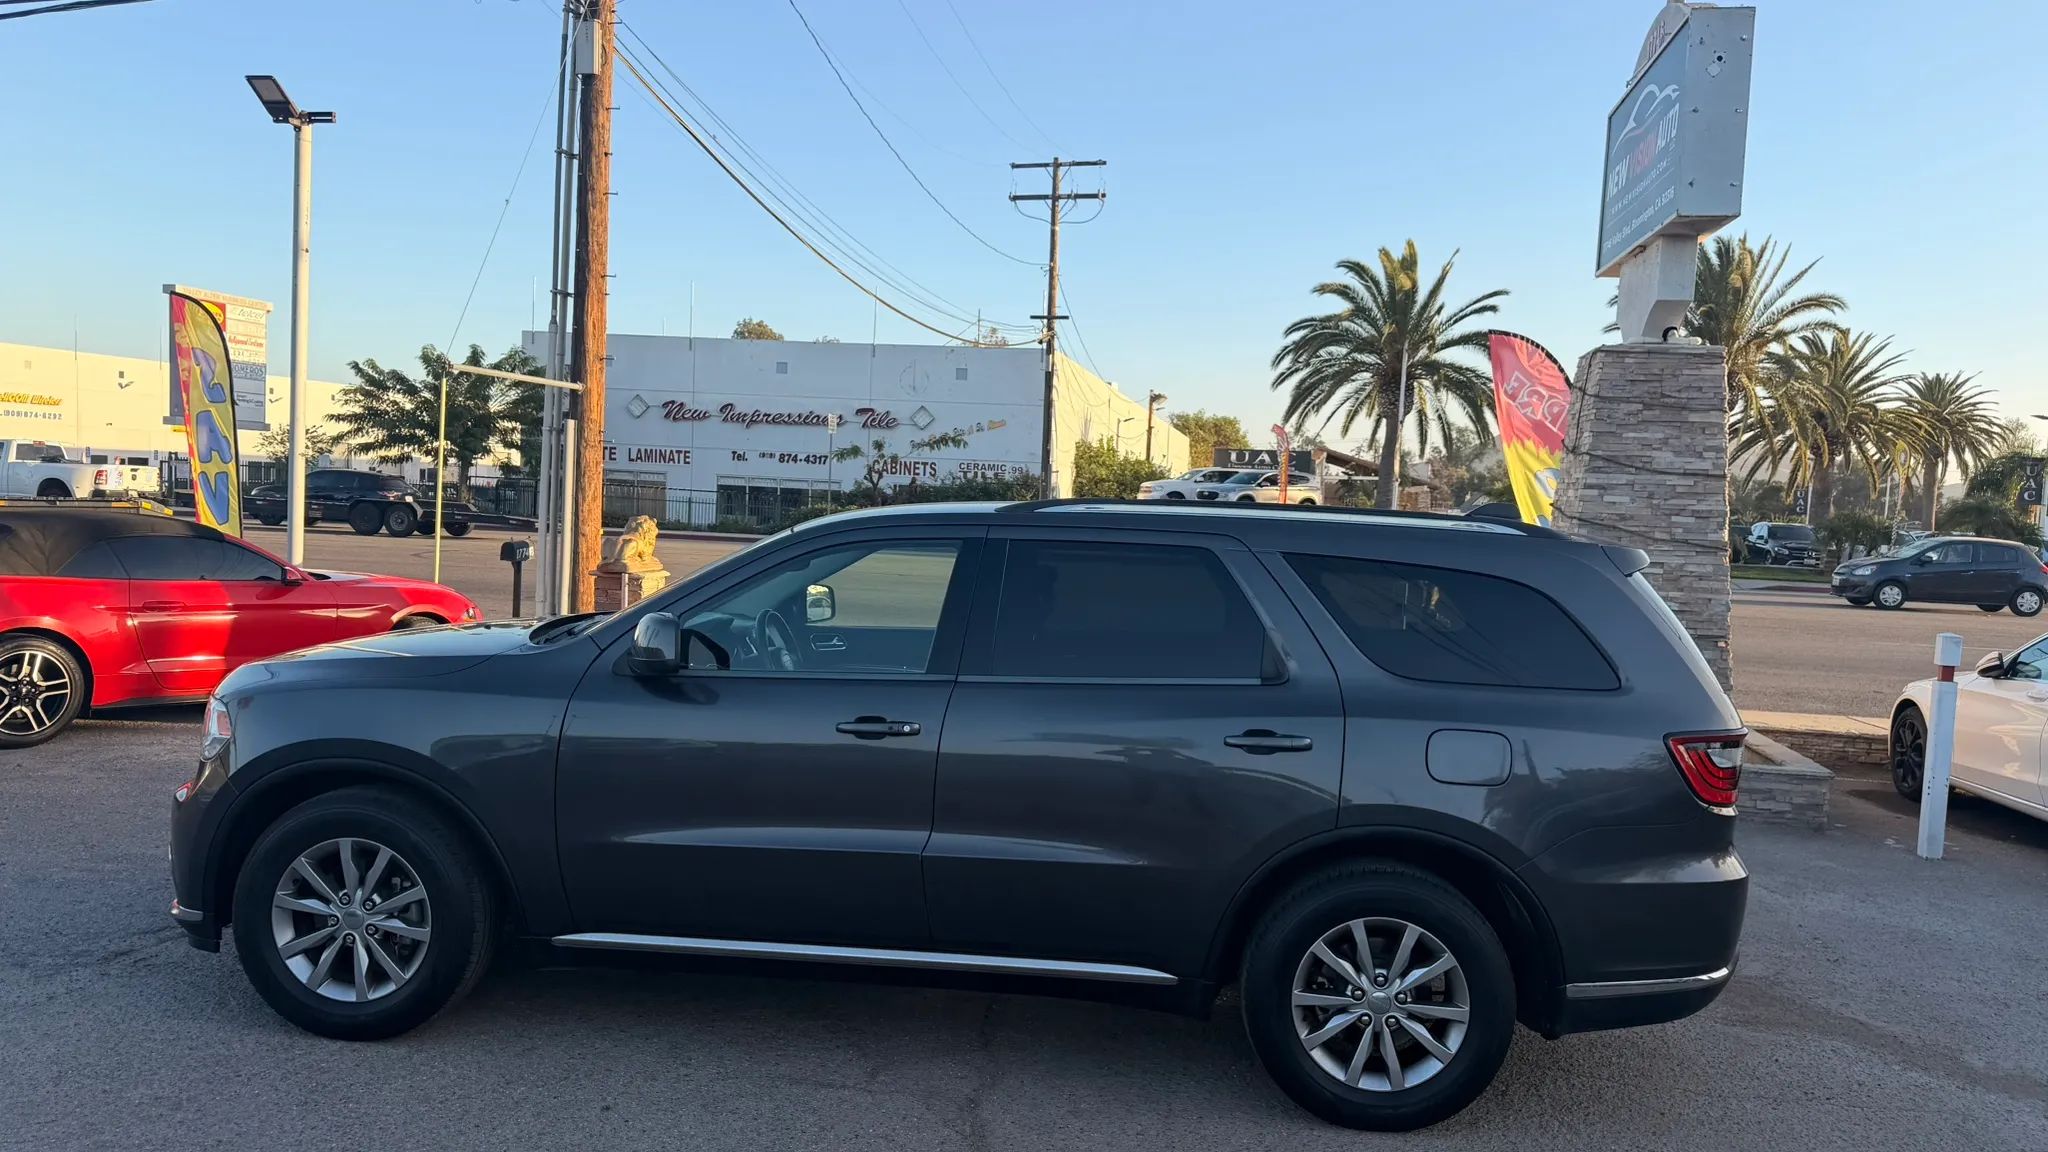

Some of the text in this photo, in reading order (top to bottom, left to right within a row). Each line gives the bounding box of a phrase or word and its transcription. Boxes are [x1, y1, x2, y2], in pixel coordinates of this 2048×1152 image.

[1606, 154, 1630, 201] NEW
[1656, 102, 1680, 154] AUTO
[661, 400, 711, 423] New
[855, 407, 900, 430] Tile
[628, 447, 691, 465] LAMINATE
[731, 450, 748, 462] Tel.
[778, 452, 829, 466] 874-4317
[872, 459, 938, 478] CABINETS
[958, 462, 1007, 473] CERAMIC
[2023, 465, 2038, 501] UAC
[1796, 490, 1805, 513] UAC
